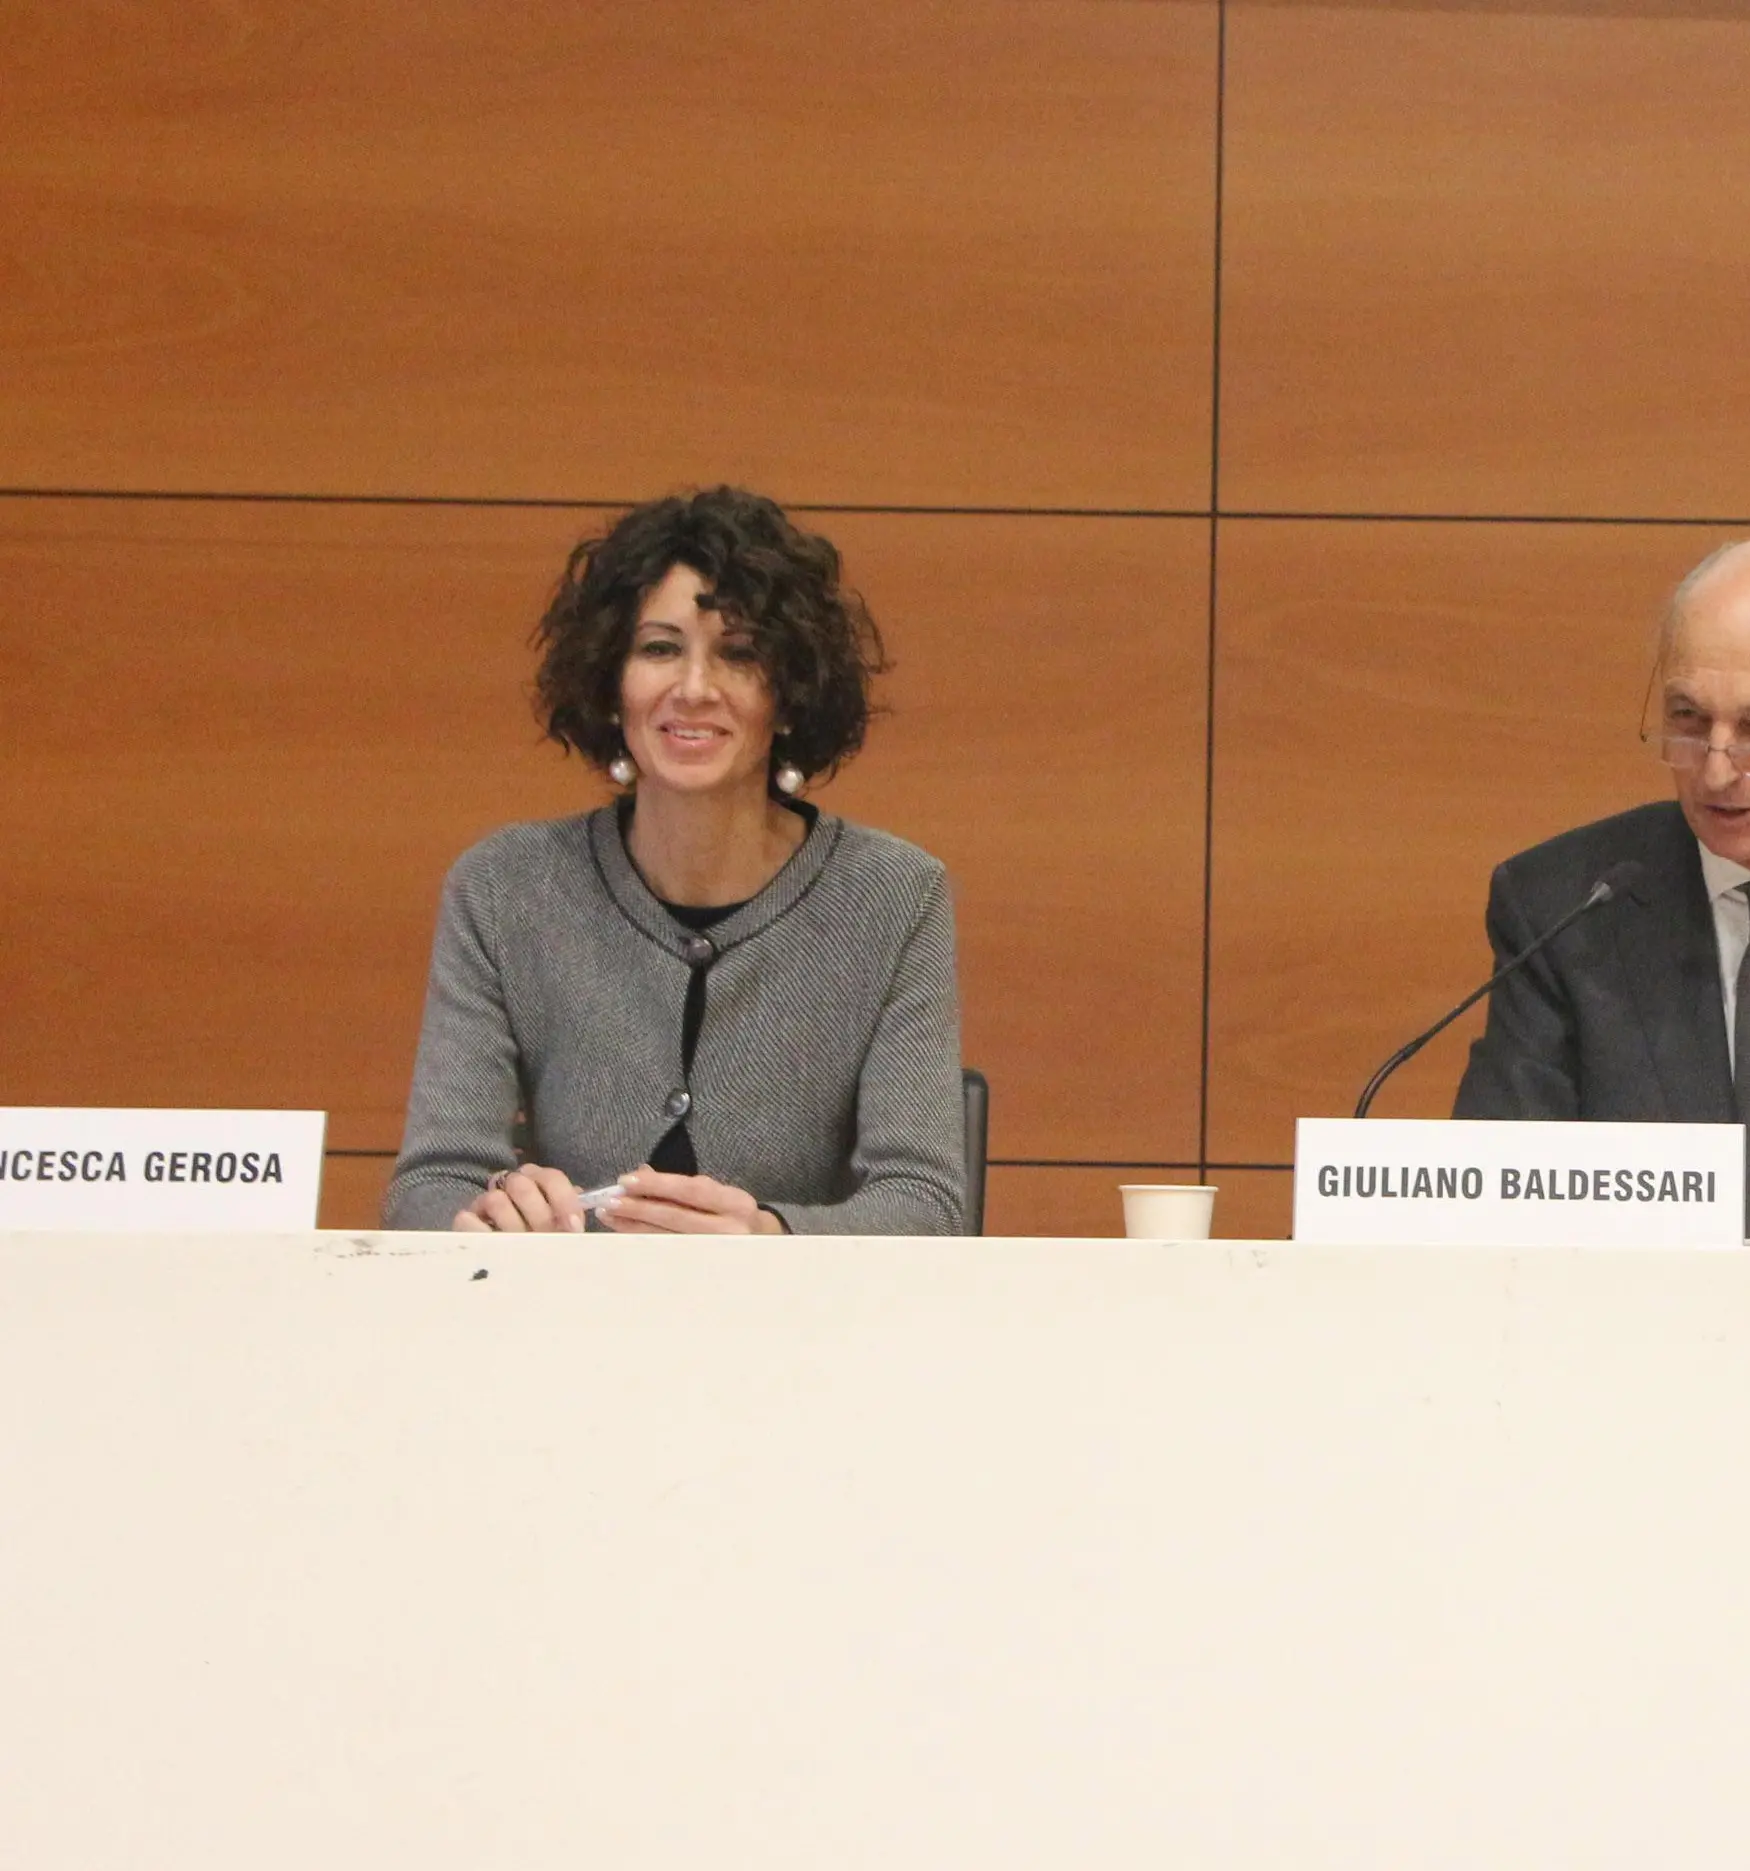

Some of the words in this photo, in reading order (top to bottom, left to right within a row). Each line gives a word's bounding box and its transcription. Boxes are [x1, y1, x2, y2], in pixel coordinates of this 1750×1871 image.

[144, 1151, 283, 1183] GEROSA
[1317, 1165, 1483, 1199] GIULIANO
[1501, 1168, 1716, 1202] BALDESSARI
